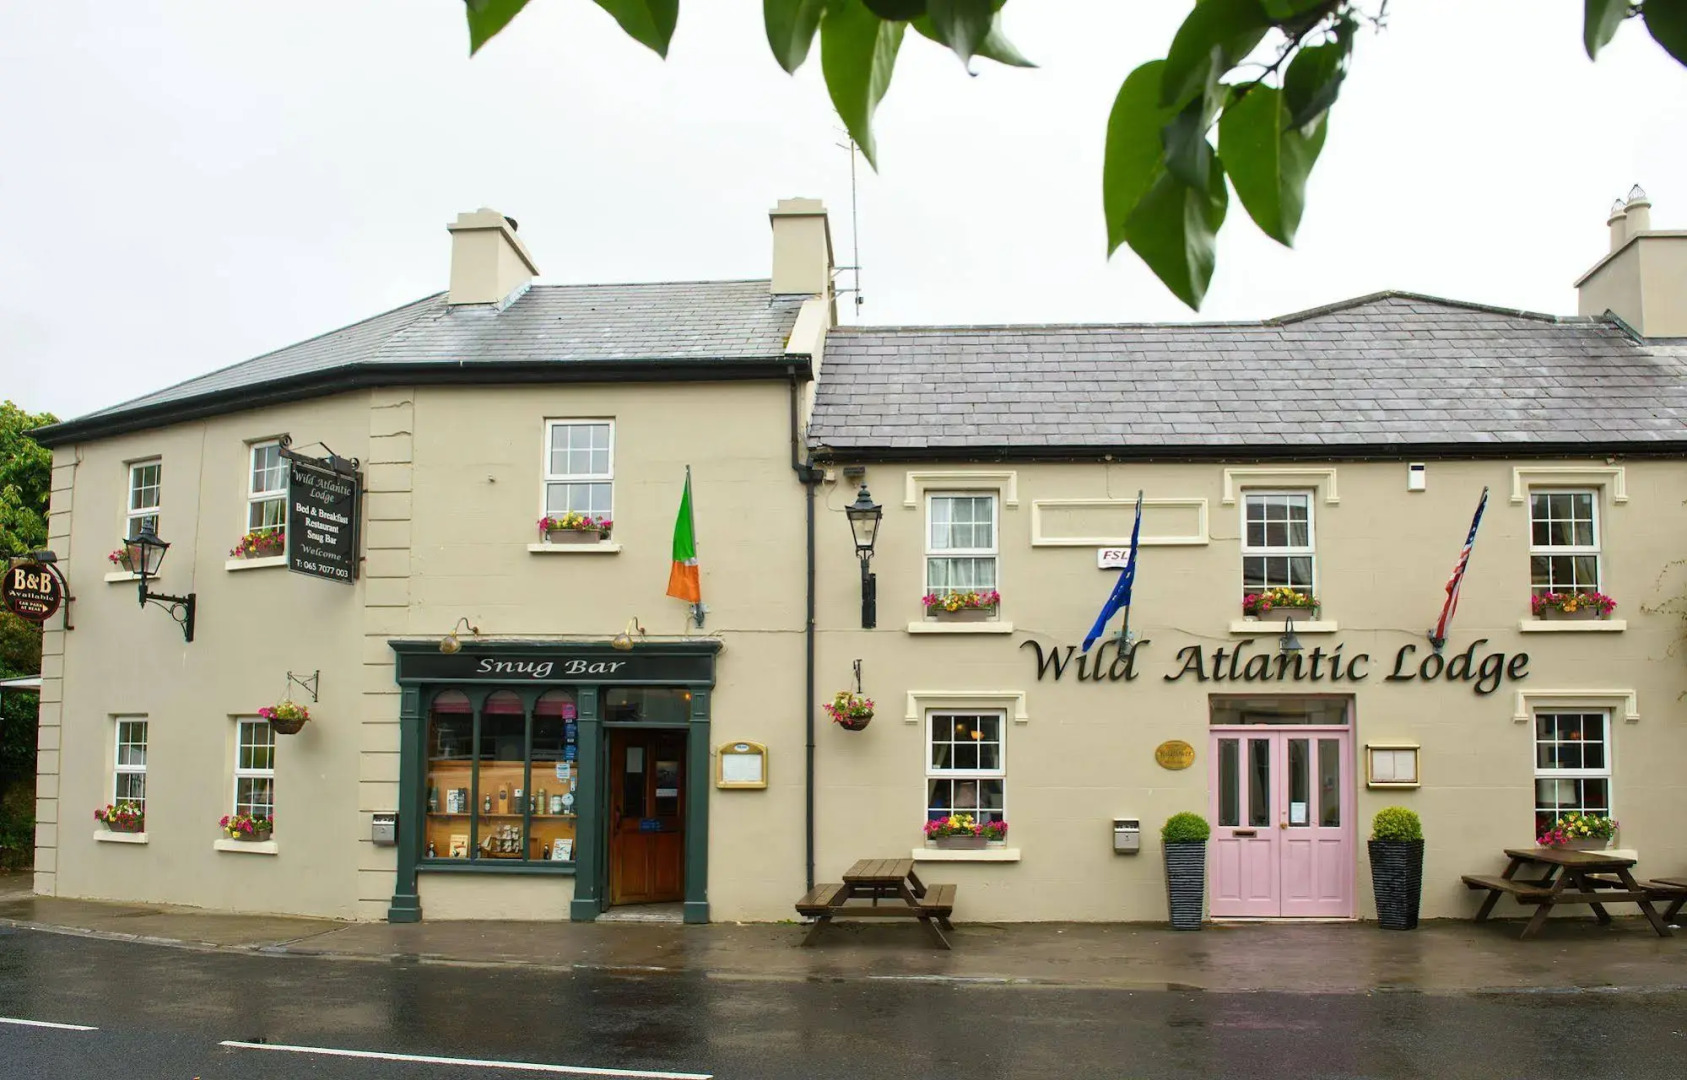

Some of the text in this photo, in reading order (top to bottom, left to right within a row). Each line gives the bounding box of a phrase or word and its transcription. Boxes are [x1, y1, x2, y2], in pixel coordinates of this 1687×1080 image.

[294, 470, 351, 496] Wild Atlantic
[310, 489, 335, 504] Lodge
[296, 503, 348, 524] Bed & Breakfast
[305, 517, 339, 533] Restaurant
[307, 530, 337, 545] Snug Bar
[301, 544, 342, 561] Welcome
[1103, 551, 1128, 560] FSL
[296, 559, 348, 578] T: 065 7077 003
[14, 569, 51, 593] B&B
[9, 590, 54, 601] Available
[476, 658, 626, 678] Snug Bar
[1019, 638, 1530, 696] Wild Atlantic Lodge
